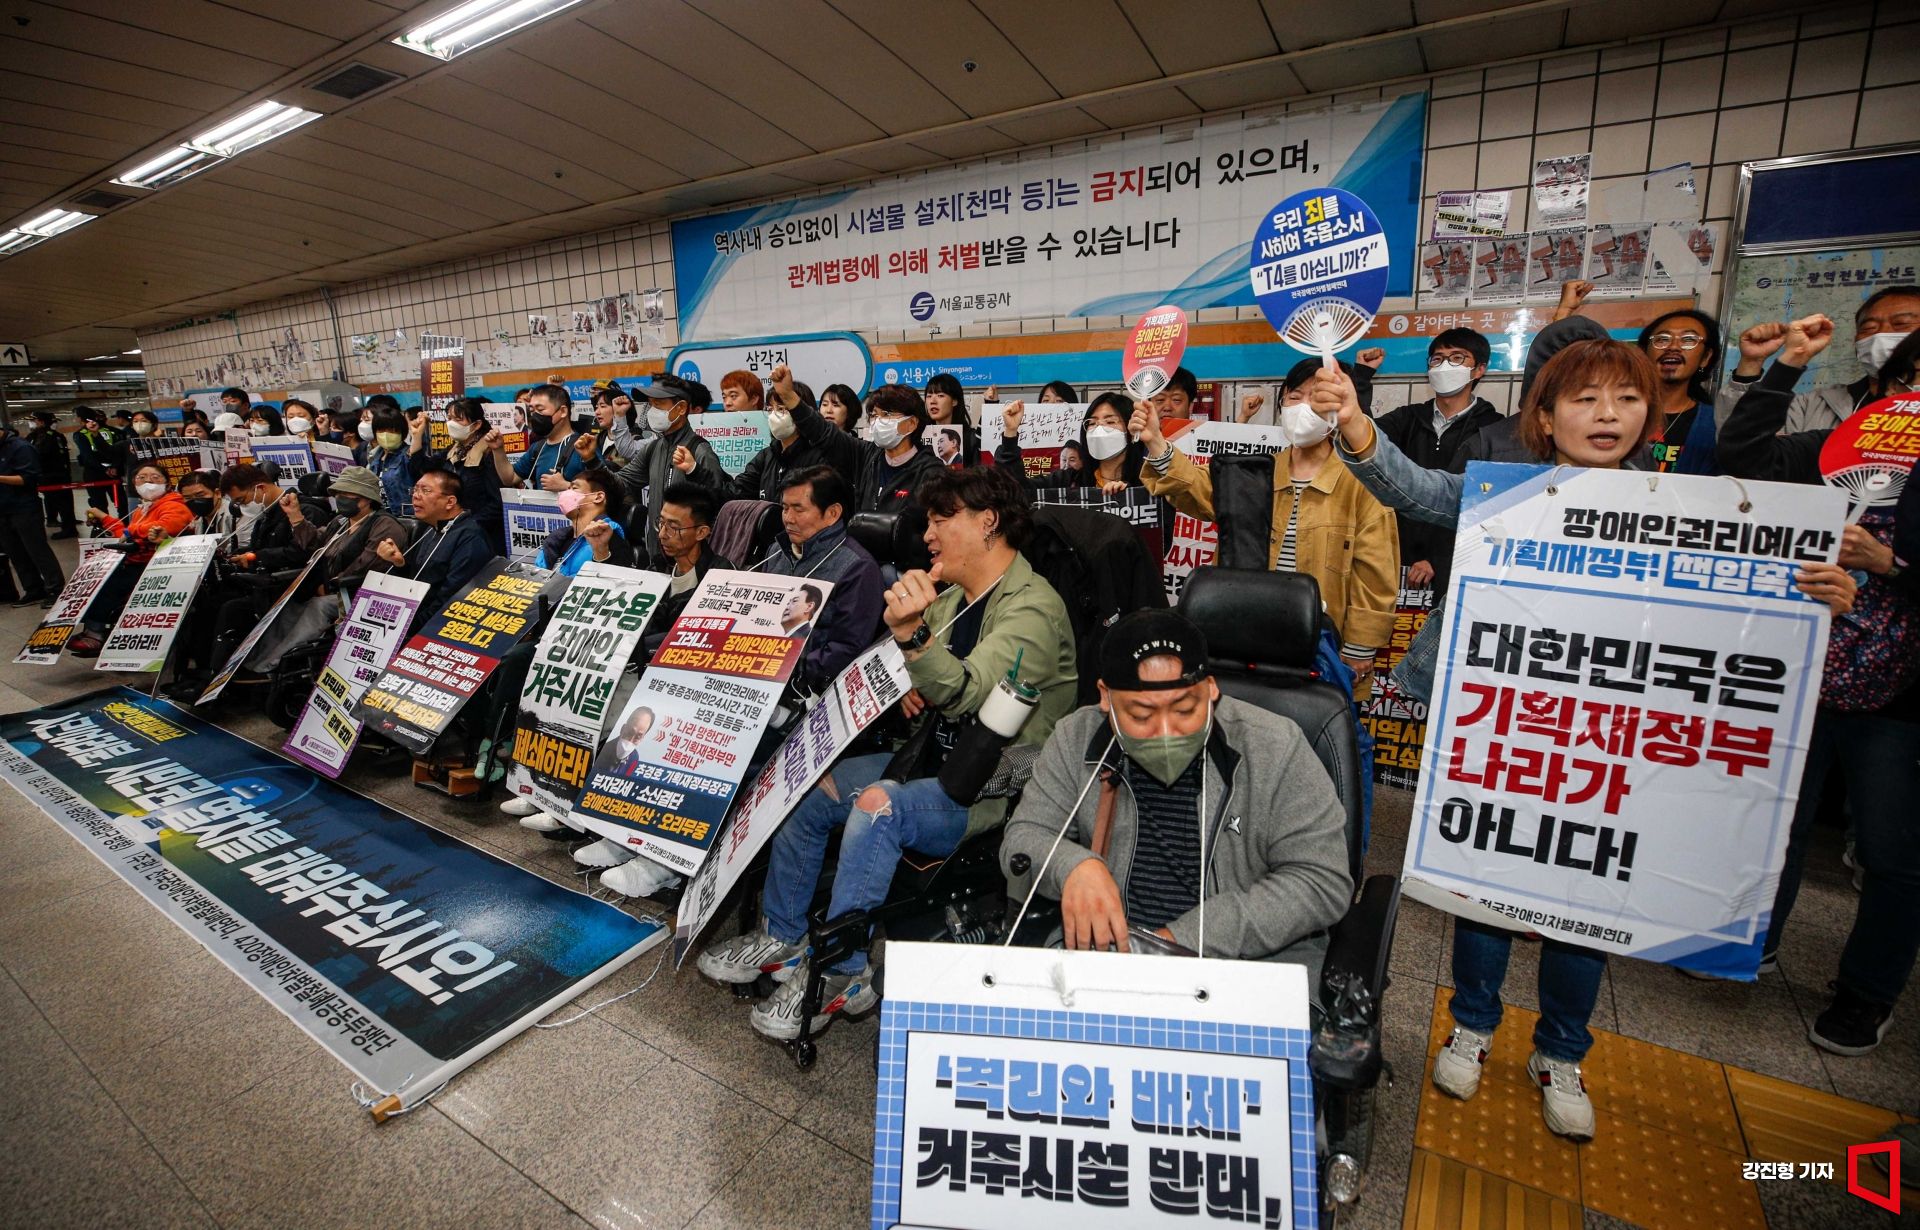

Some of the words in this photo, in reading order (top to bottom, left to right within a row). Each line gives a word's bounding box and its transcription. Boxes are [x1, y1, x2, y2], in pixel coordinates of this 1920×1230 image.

[714, 231, 762, 255] 역사내
[768, 214, 839, 246] 승인없이
[846, 203, 906, 236] 시설물
[914, 185, 1012, 226] 설치[천막
[1020, 179, 1080, 210] 등]는
[1090, 157, 1201, 203] 금지되어
[1216, 139, 1320, 185] 있으며,
[1273, 208, 1302, 233] 우리
[1304, 195, 1340, 225] 죄를
[1261, 231, 1301, 259] 사하여
[1303, 211, 1365, 247] 주옵소서
[787, 254, 880, 289] 관계법령에
[888, 248, 929, 276] 의해
[937, 235, 1028, 271] 처벌받을
[1037, 232, 1062, 261] 수
[1073, 218, 1181, 258] 있습니다
[1257, 264, 1298, 291] “T4를
[1300, 241, 1379, 281] 아십니까?”
[939, 291, 1012, 312] 서울교통공사
[1135, 323, 1183, 344] 장애인권리
[1414, 313, 1475, 330] 갈아타는
[1480, 312, 1496, 329] 곳
[746, 349, 788, 371] 삼각지
[1135, 340, 1173, 358] 예산보장
[431, 361, 452, 372] 이동하고
[431, 372, 452, 383] 교육받고
[902, 367, 935, 384] 신용산
[1563, 508, 1836, 560] 장애인권리예산
[138, 575, 171, 591] 장애인
[1483, 537, 1661, 583] 기획재정부
[1670, 556, 1797, 597] 책임촉
[129, 592, 162, 608] 탈시설
[161, 592, 187, 607] 예산
[464, 587, 534, 615] 비장애인도
[488, 575, 544, 597] 장애인도
[706, 583, 731, 597] “우리는
[731, 588, 752, 600] 세계
[752, 590, 785, 605] 10위권
[119, 613, 179, 629] 6224억으로
[442, 601, 488, 624] 안전한
[479, 611, 527, 636] 세상을
[555, 586, 657, 632] 집단수용
[698, 597, 732, 613] 경제대국
[732, 604, 757, 617] 그룹”
[438, 620, 496, 649] 원합니다.
[677, 618, 704, 629] 윤석열
[703, 619, 731, 631] 대통령
[107, 634, 162, 650] 보장하라!!
[546, 624, 624, 672] 장애인
[722, 635, 792, 657] 장애인예산
[659, 648, 713, 667] OECD국가
[714, 653, 784, 677] 최하위그룹
[1465, 621, 1787, 713] 대한민국은
[523, 662, 614, 721] 거주시설
[704, 676, 770, 706] “장애인권리예산,
[676, 719, 697, 737] “나라
[693, 708, 715, 724] 보장
[740, 703, 762, 721] 지원
[1455, 681, 1775, 777] 기획재정부
[512, 727, 591, 788] 폐쇄하라!
[669, 734, 681, 750] “왜
[680, 738, 737, 768] 기획재정부만
[591, 773, 634, 797] 부자감세
[636, 786, 684, 810] 소신결단
[634, 763, 664, 781] 추경호
[662, 769, 732, 797] 기획재정부장관
[1447, 737, 1631, 815] 나라가
[581, 792, 655, 825] 장애인권리예산
[656, 813, 711, 841] 오리무중
[1438, 797, 1639, 883] 아니다!
[26, 711, 144, 768] 시민여러분,
[240, 842, 517, 1005] 태워주십시오!
[1478, 897, 1633, 946] 전국장애인차별철폐연대
[233, 935, 399, 1057] 420장애인차별철폐공동투쟁단
[916, 1127, 1129, 1207] 거주시설
[1149, 1147, 1282, 1230] 반대,
